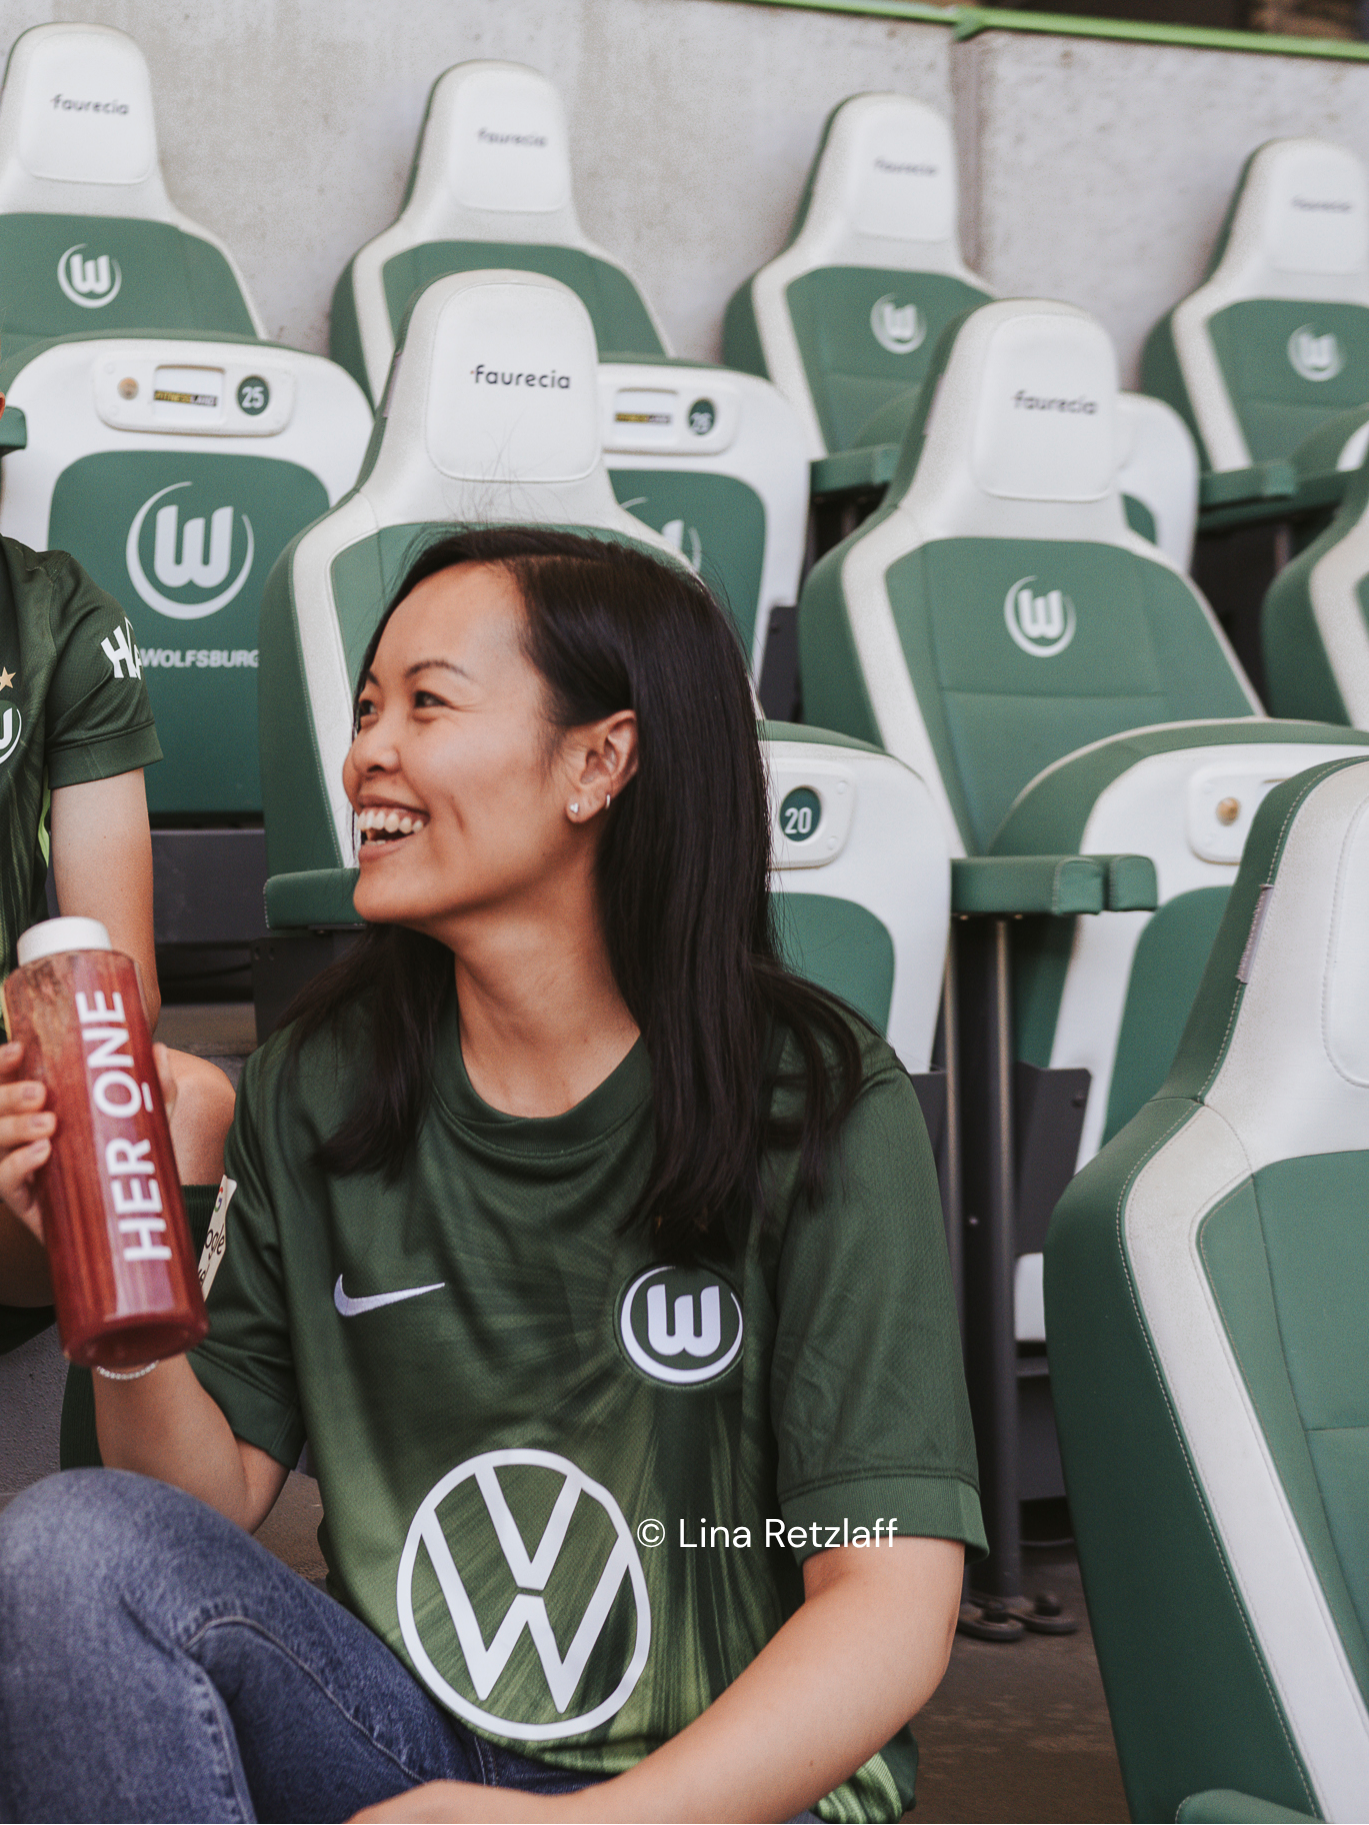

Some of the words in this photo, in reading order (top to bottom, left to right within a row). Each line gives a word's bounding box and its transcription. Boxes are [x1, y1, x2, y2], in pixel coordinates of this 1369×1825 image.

[52, 94, 129, 115] faurecia
[475, 364, 570, 389] faurecia
[242, 386, 265, 409] 25
[1014, 389, 1098, 414] faurecia
[784, 807, 812, 834] 20
[75, 990, 154, 1119] ONE
[105, 1137, 172, 1261] HER
